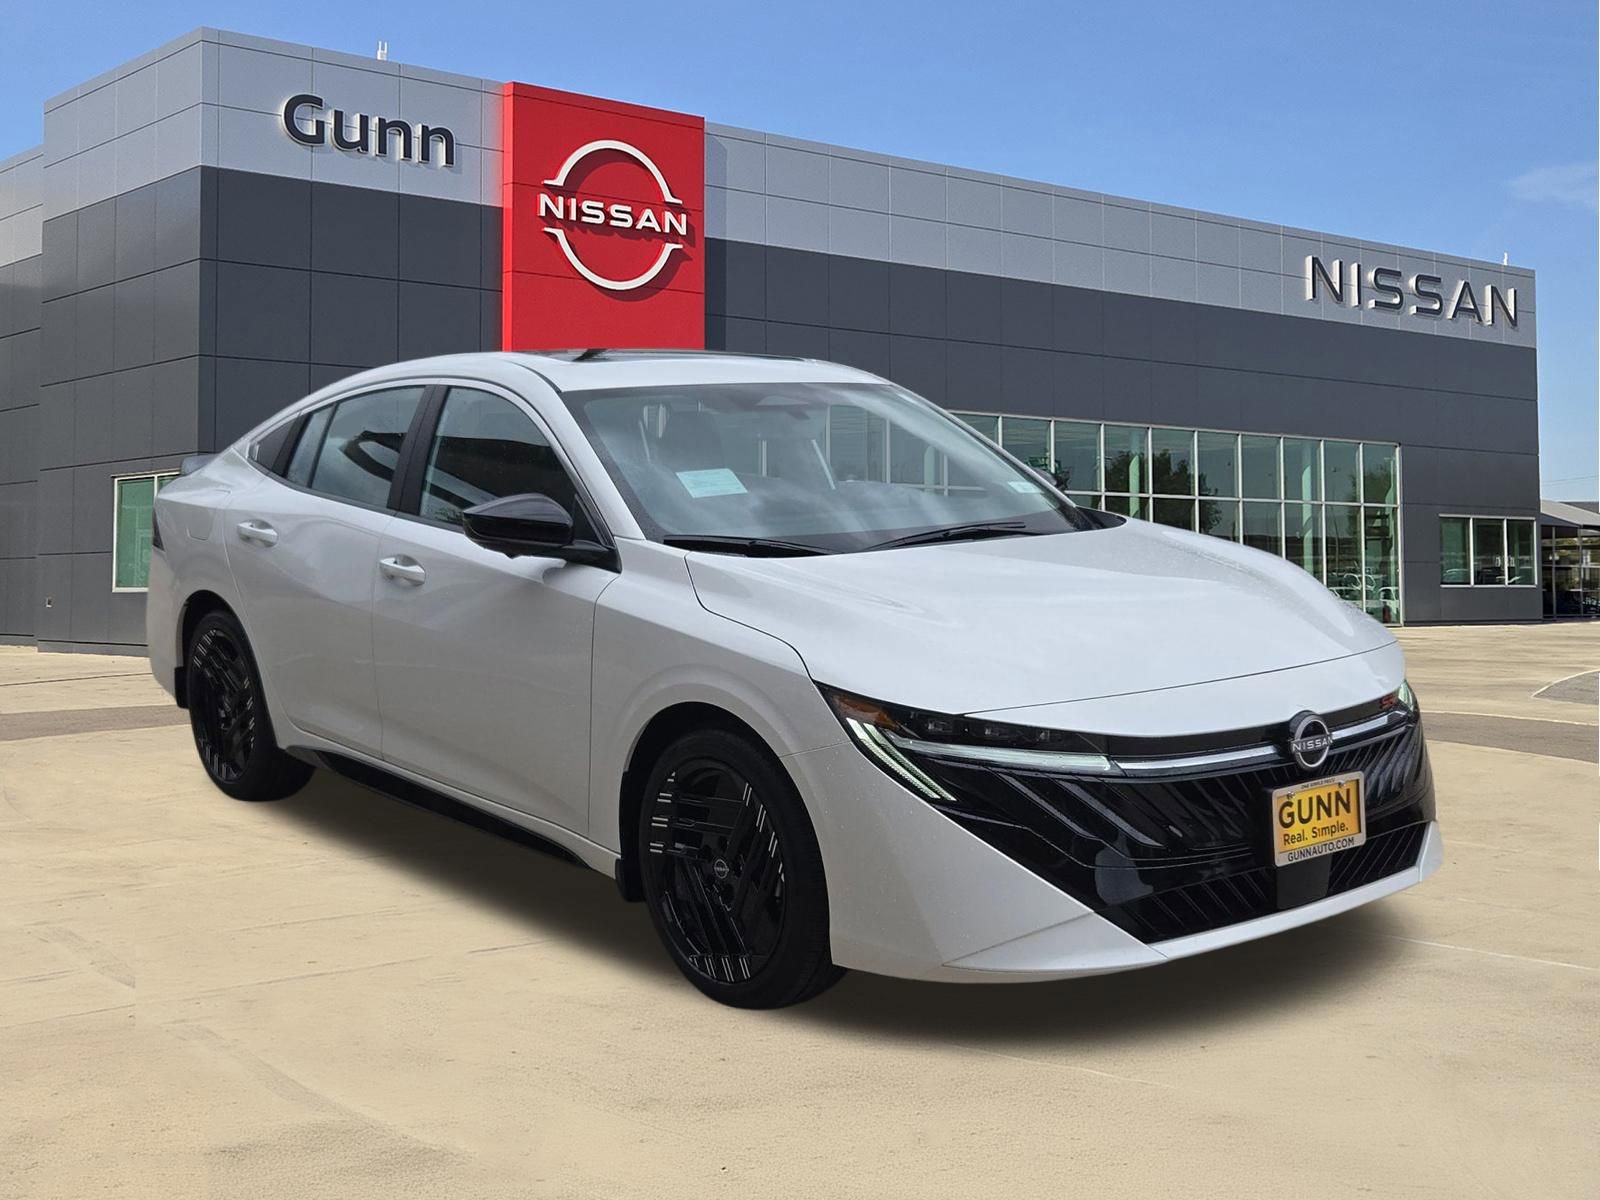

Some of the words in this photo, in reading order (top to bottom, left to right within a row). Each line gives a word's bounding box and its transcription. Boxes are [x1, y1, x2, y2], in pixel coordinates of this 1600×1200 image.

[282, 94, 456, 167] Gunn
[537, 193, 687, 236] NISSAN
[1305, 255, 1518, 327] NISSAN
[1292, 736, 1333, 751] NISSAN
[1279, 788, 1351, 829] GUNN
[1283, 829, 1308, 846] Real.
[1311, 821, 1349, 838] Simple.
[1288, 836, 1355, 862] GUNNAUTO.COM
